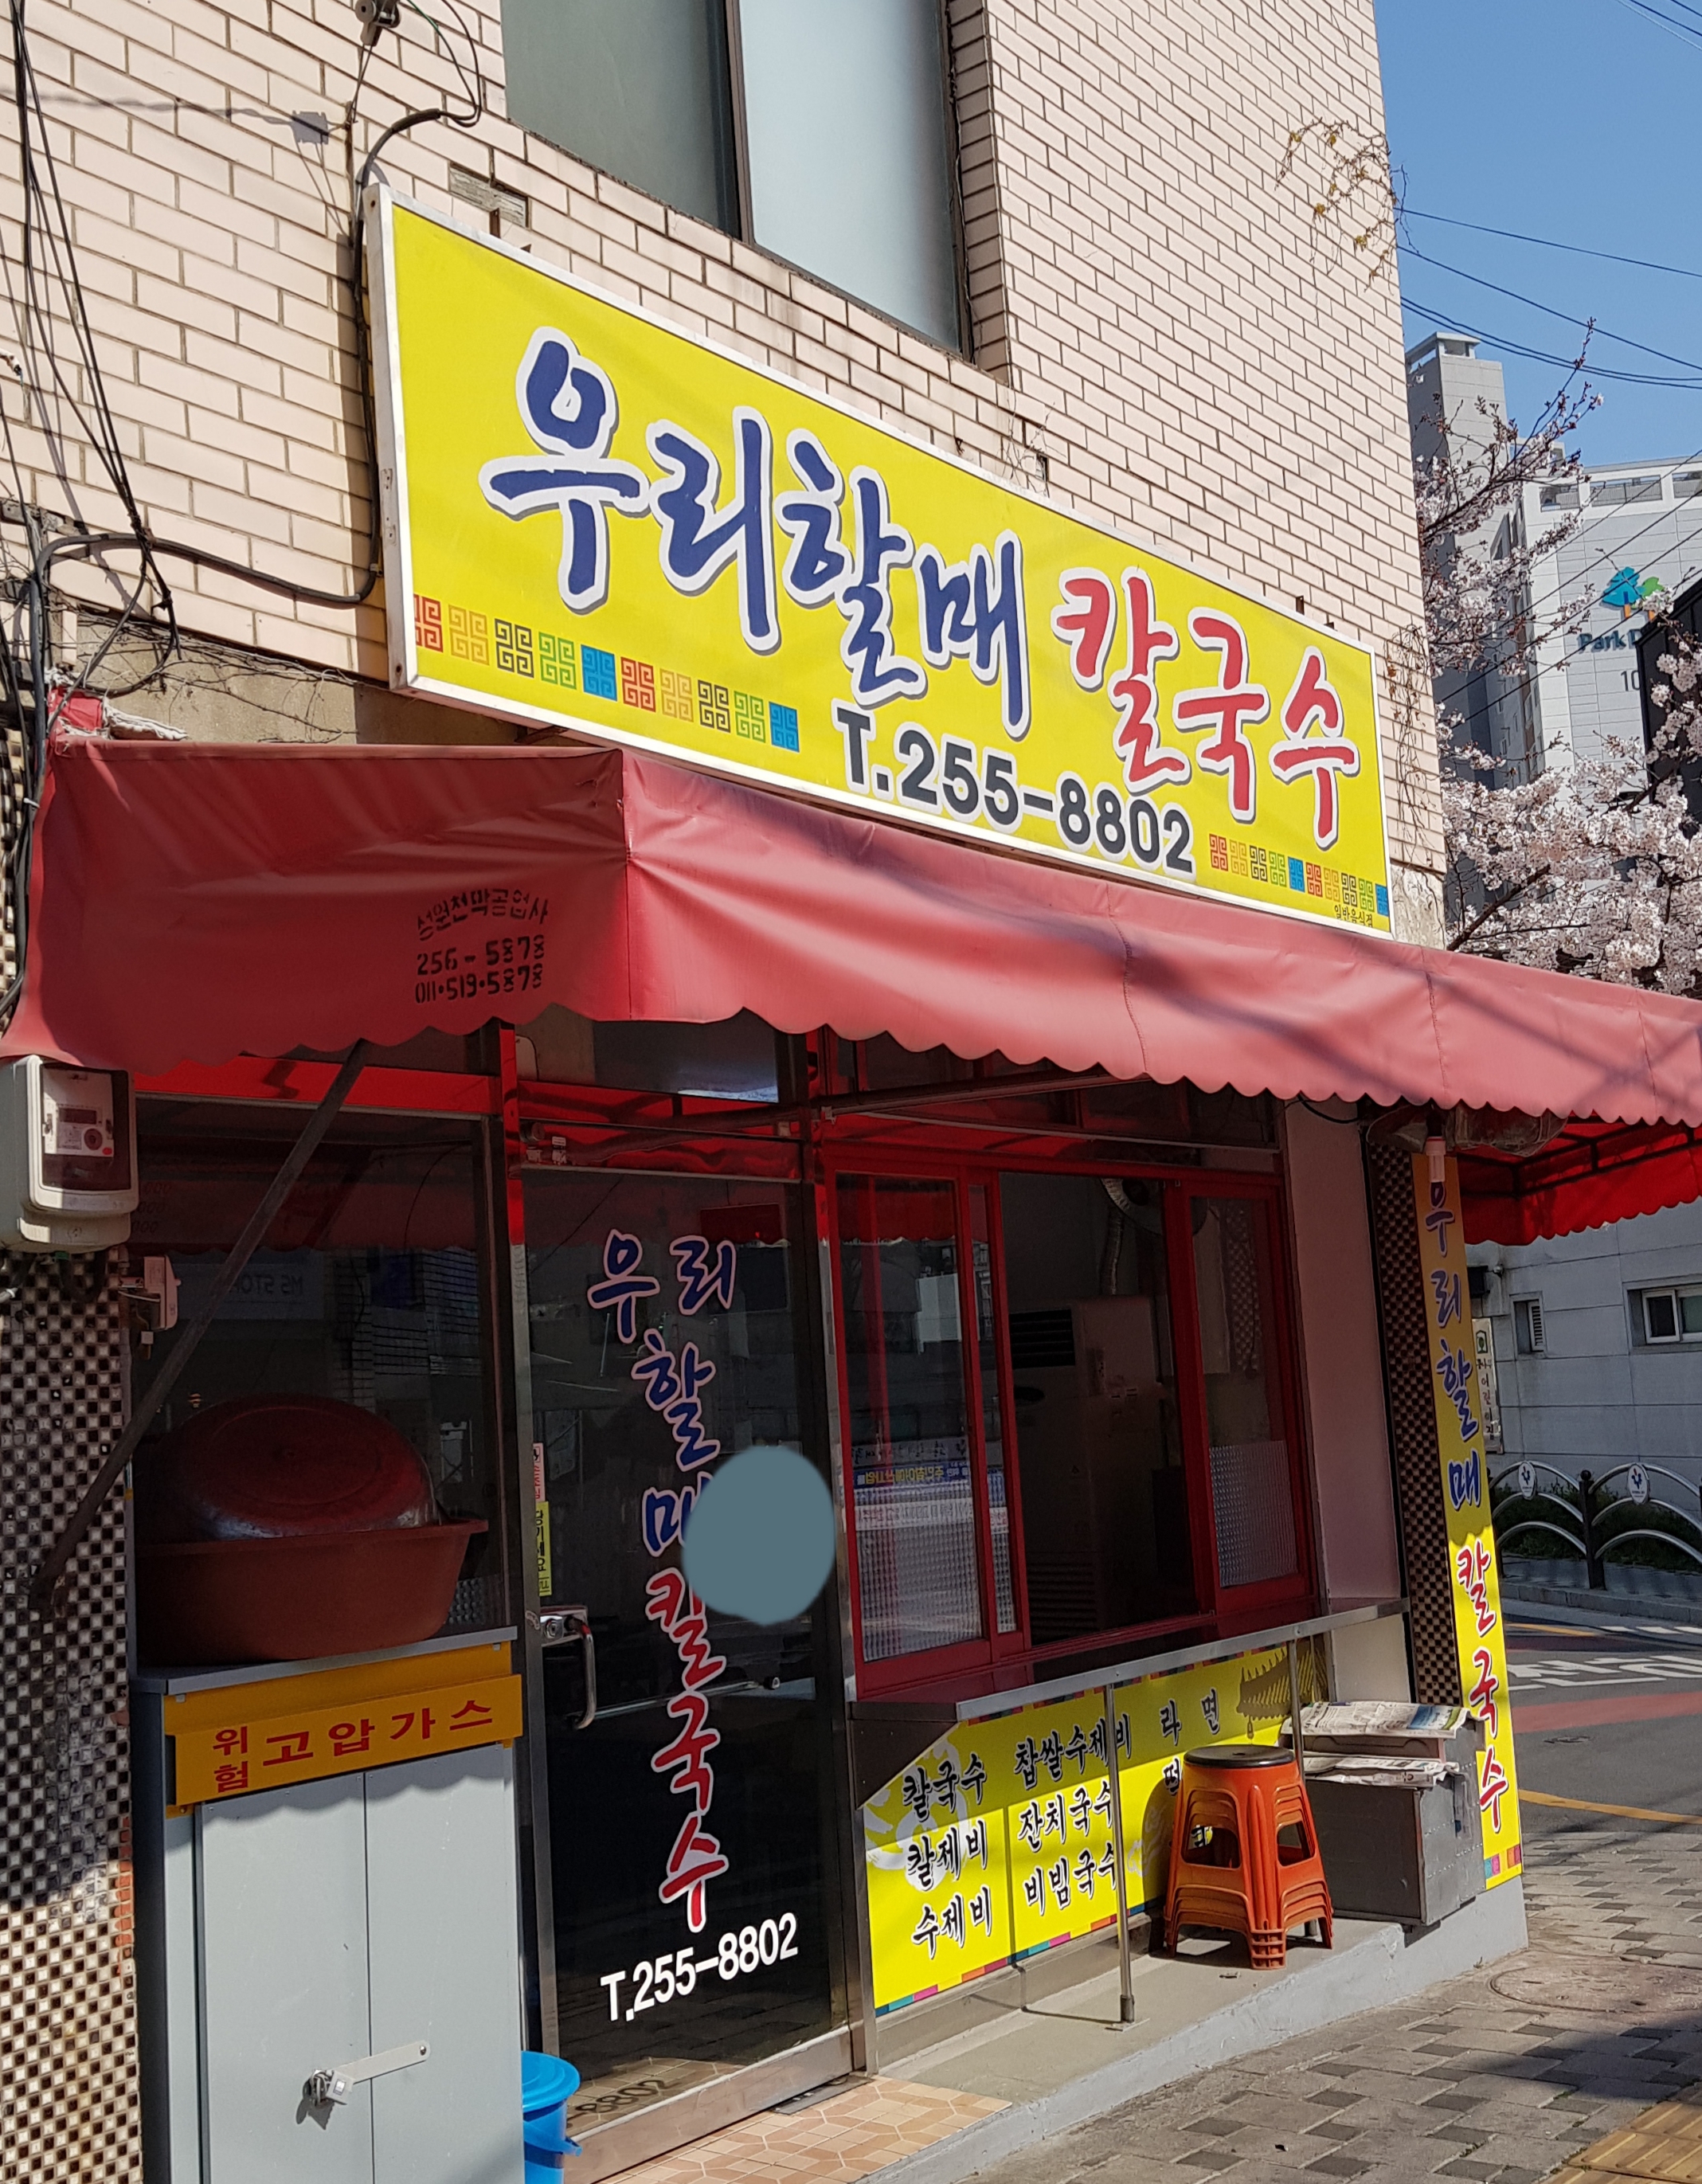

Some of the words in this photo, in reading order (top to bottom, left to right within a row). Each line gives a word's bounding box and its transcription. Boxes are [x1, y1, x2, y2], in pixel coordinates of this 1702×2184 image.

[483, 331, 1027, 733] 우리할매
[1055, 573, 1356, 843] 칼국수
[1576, 629, 1627, 655] Park
[835, 709, 1194, 874] T.255-8802
[1334, 904, 1373, 928] 일반음식점
[417, 934, 545, 976] 256-5878
[1456, 1538, 1508, 1833] 칼국수
[212, 1725, 248, 1794] 위험
[262, 1699, 493, 1767] 고압가스
[1014, 1712, 1132, 1791] 찹쌀수제비
[902, 1753, 986, 1821] 칼국수
[1018, 1779, 1113, 1853] 잔치국수
[907, 1818, 988, 1891] 칼제비
[1023, 1842, 1117, 1916] 비빔국수
[911, 1885, 992, 1959] 수제비
[600, 1912, 798, 2022] T.255-8802
